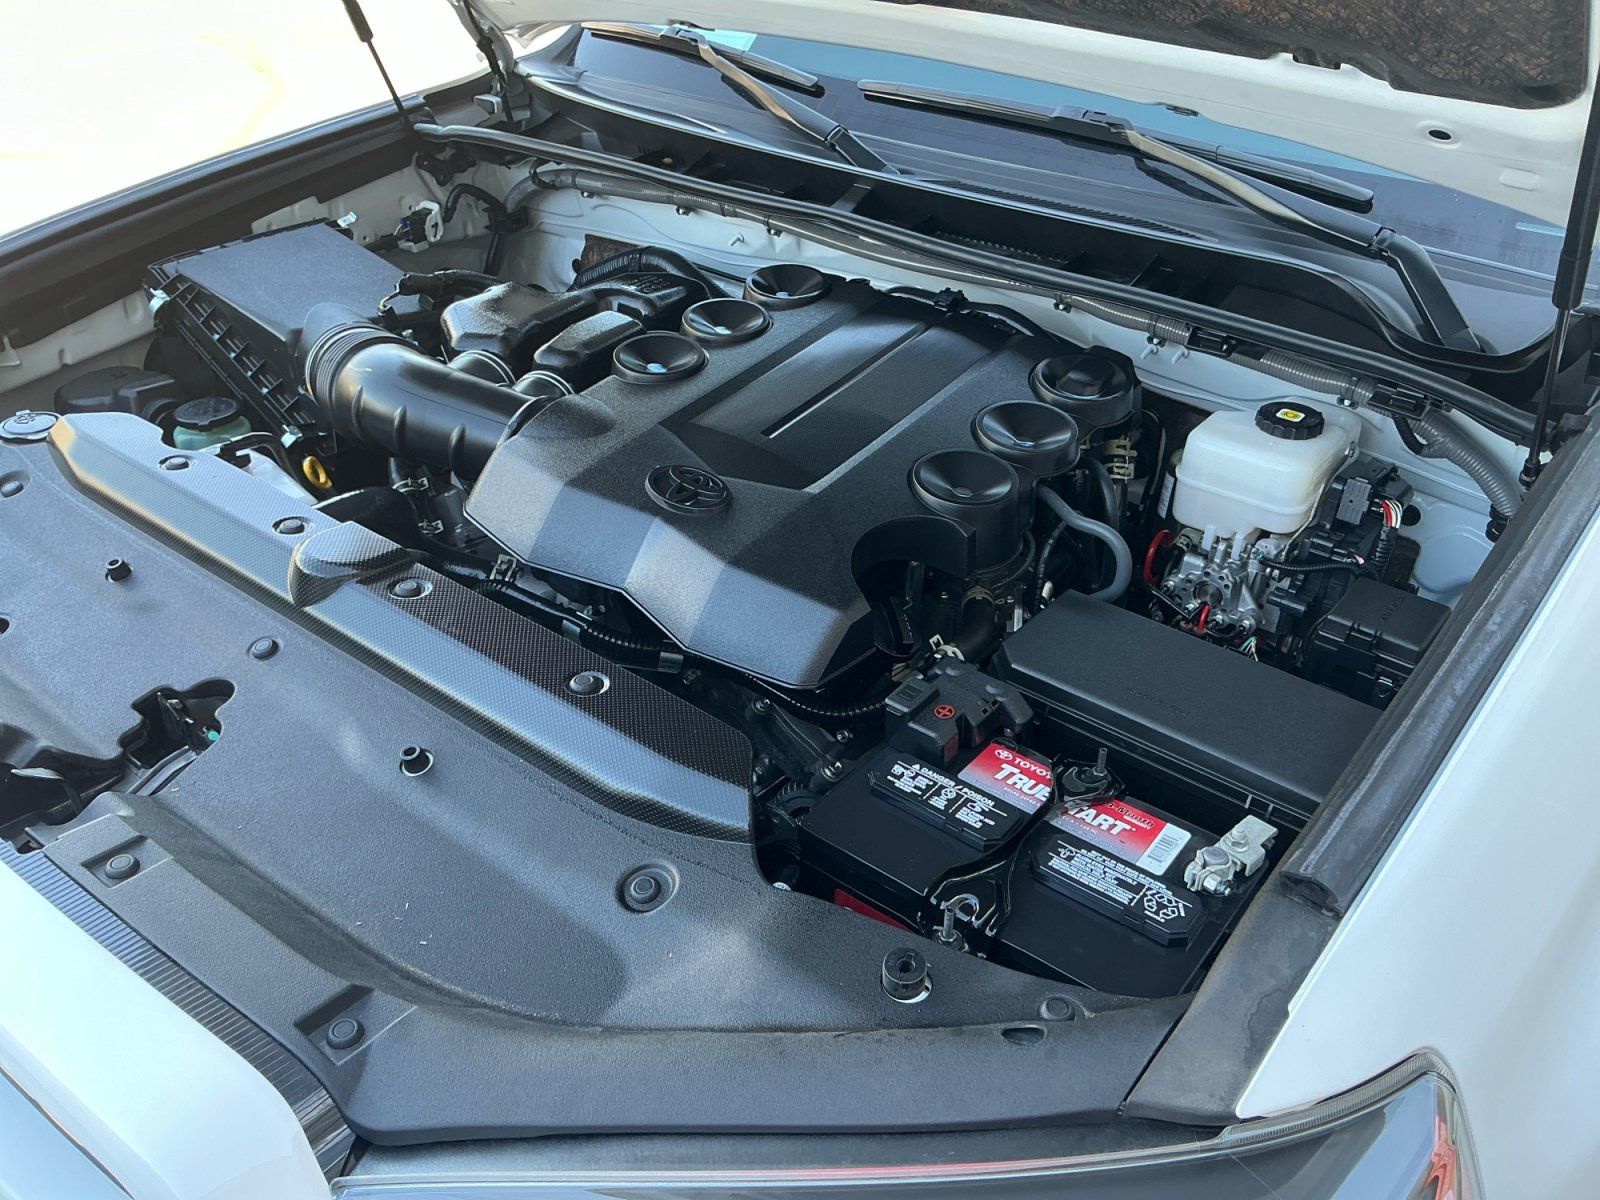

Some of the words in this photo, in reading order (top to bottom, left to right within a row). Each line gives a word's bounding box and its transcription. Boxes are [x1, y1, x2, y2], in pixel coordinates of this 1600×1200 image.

[1014, 757, 1052, 779] TOYOT
[920, 767, 956, 787] DANGER
[962, 787, 995, 807] POISON
